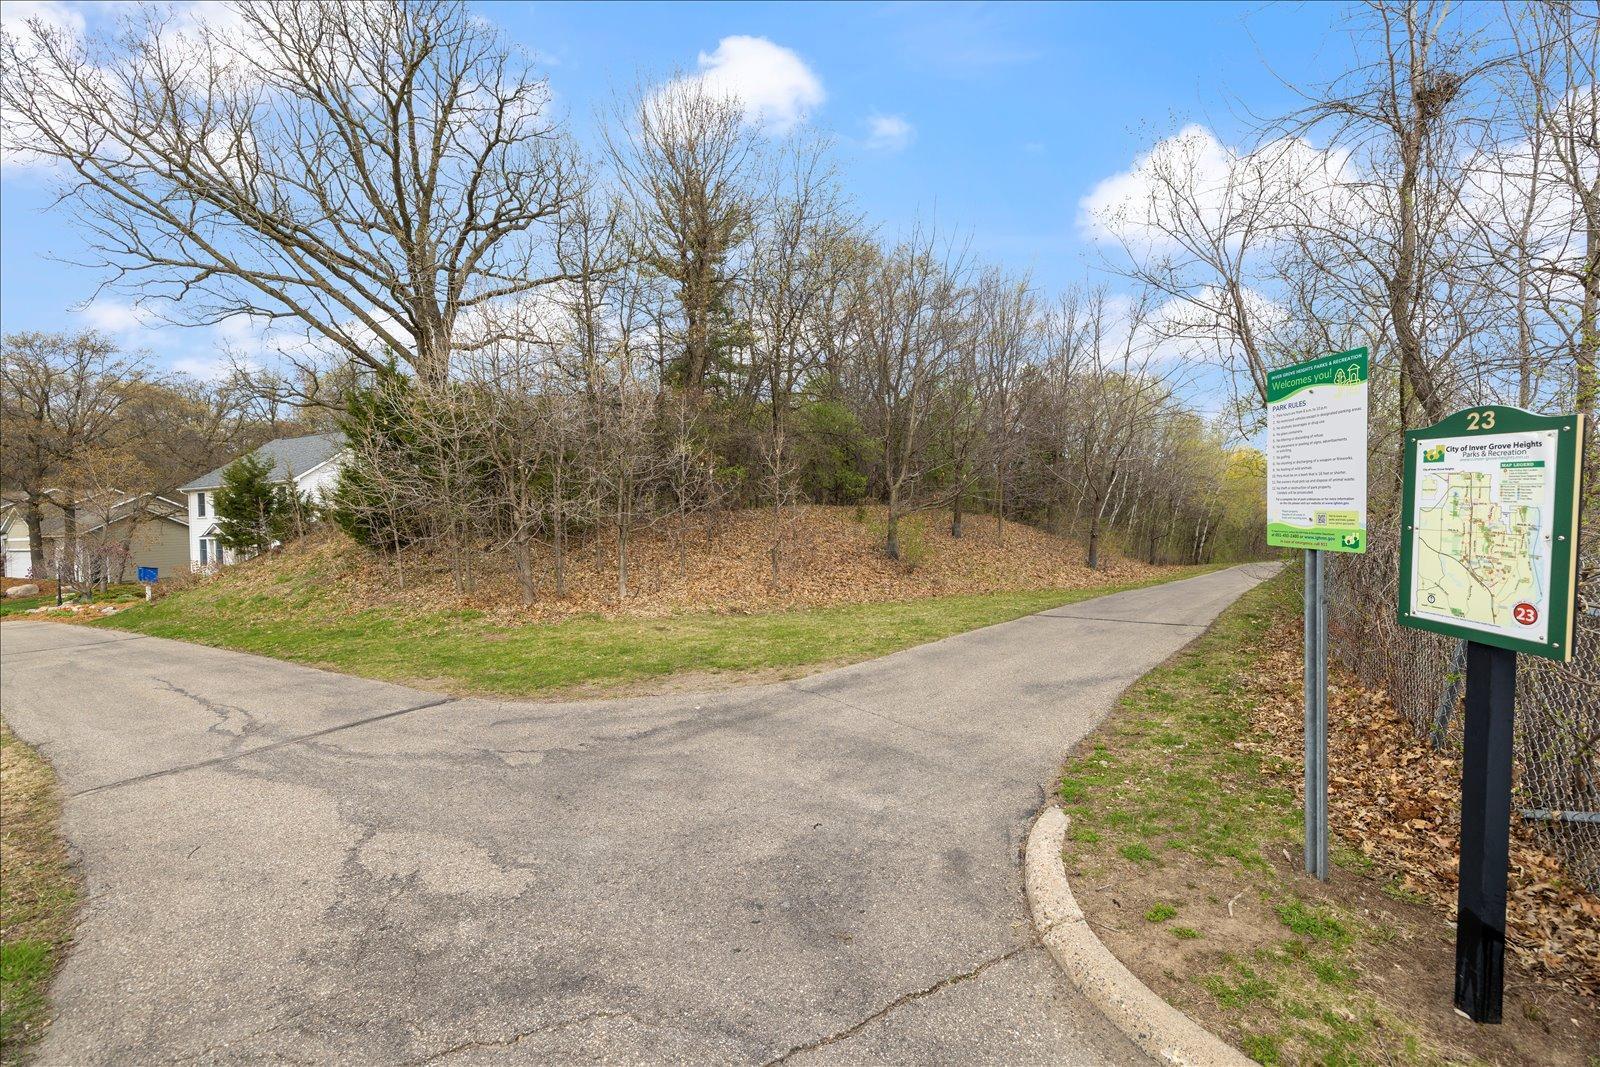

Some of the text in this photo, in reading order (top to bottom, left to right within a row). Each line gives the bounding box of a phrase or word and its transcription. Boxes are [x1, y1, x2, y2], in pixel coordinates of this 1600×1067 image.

[1333, 353, 1363, 365] RECREATION
[1272, 368, 1332, 390] Welcomes you!
[1272, 400, 1306, 412] PARK RULES
[1466, 410, 1495, 430] 23
[1446, 445, 1459, 453] City
[1489, 442, 1512, 450] Grove
[1513, 440, 1542, 450] Heights
[1516, 608, 1535, 622] 23
